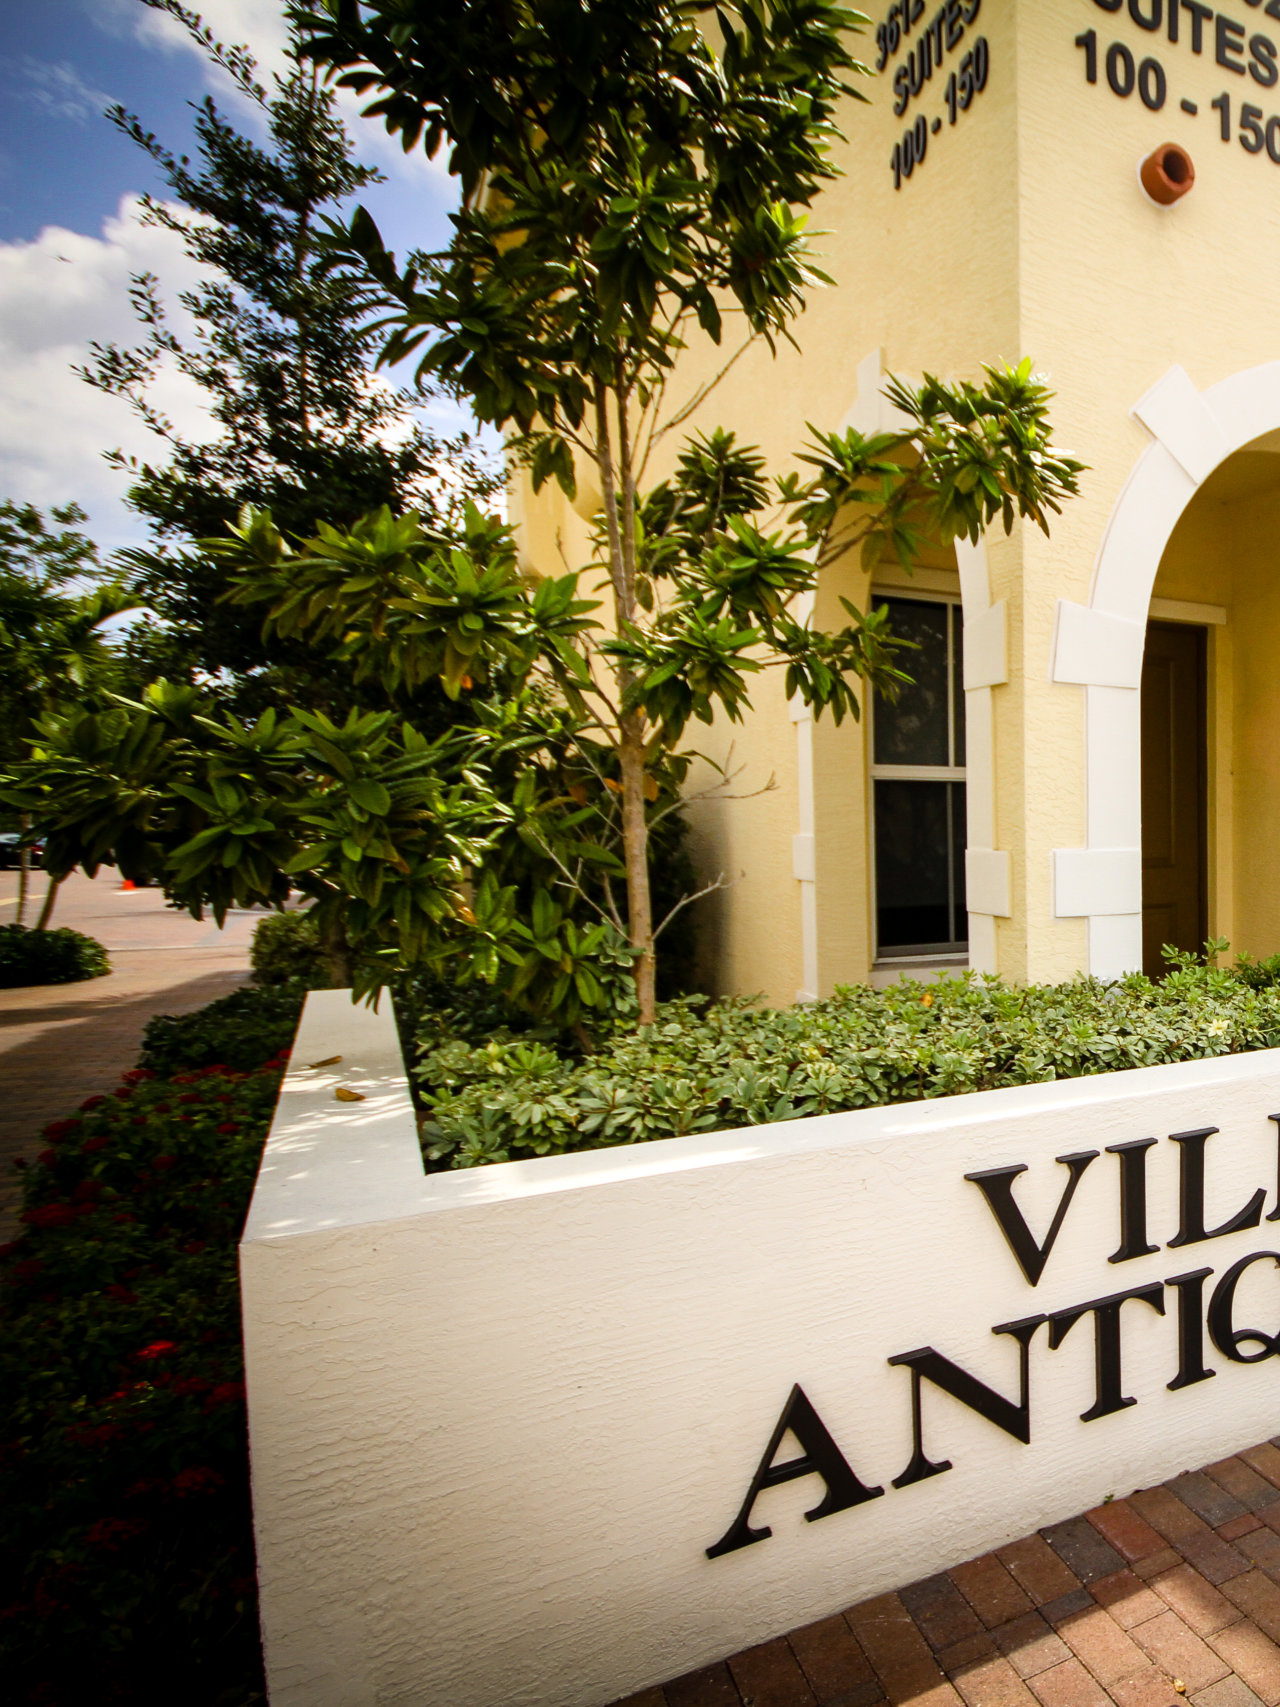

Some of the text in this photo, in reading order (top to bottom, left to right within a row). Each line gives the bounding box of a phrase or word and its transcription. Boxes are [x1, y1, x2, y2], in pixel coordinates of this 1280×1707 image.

[1075, 28, 1167, 112] 100
[1087, 0, 1279, 88] UITES
[891, 115, 928, 191] 100
[944, 36, 990, 127] 150
